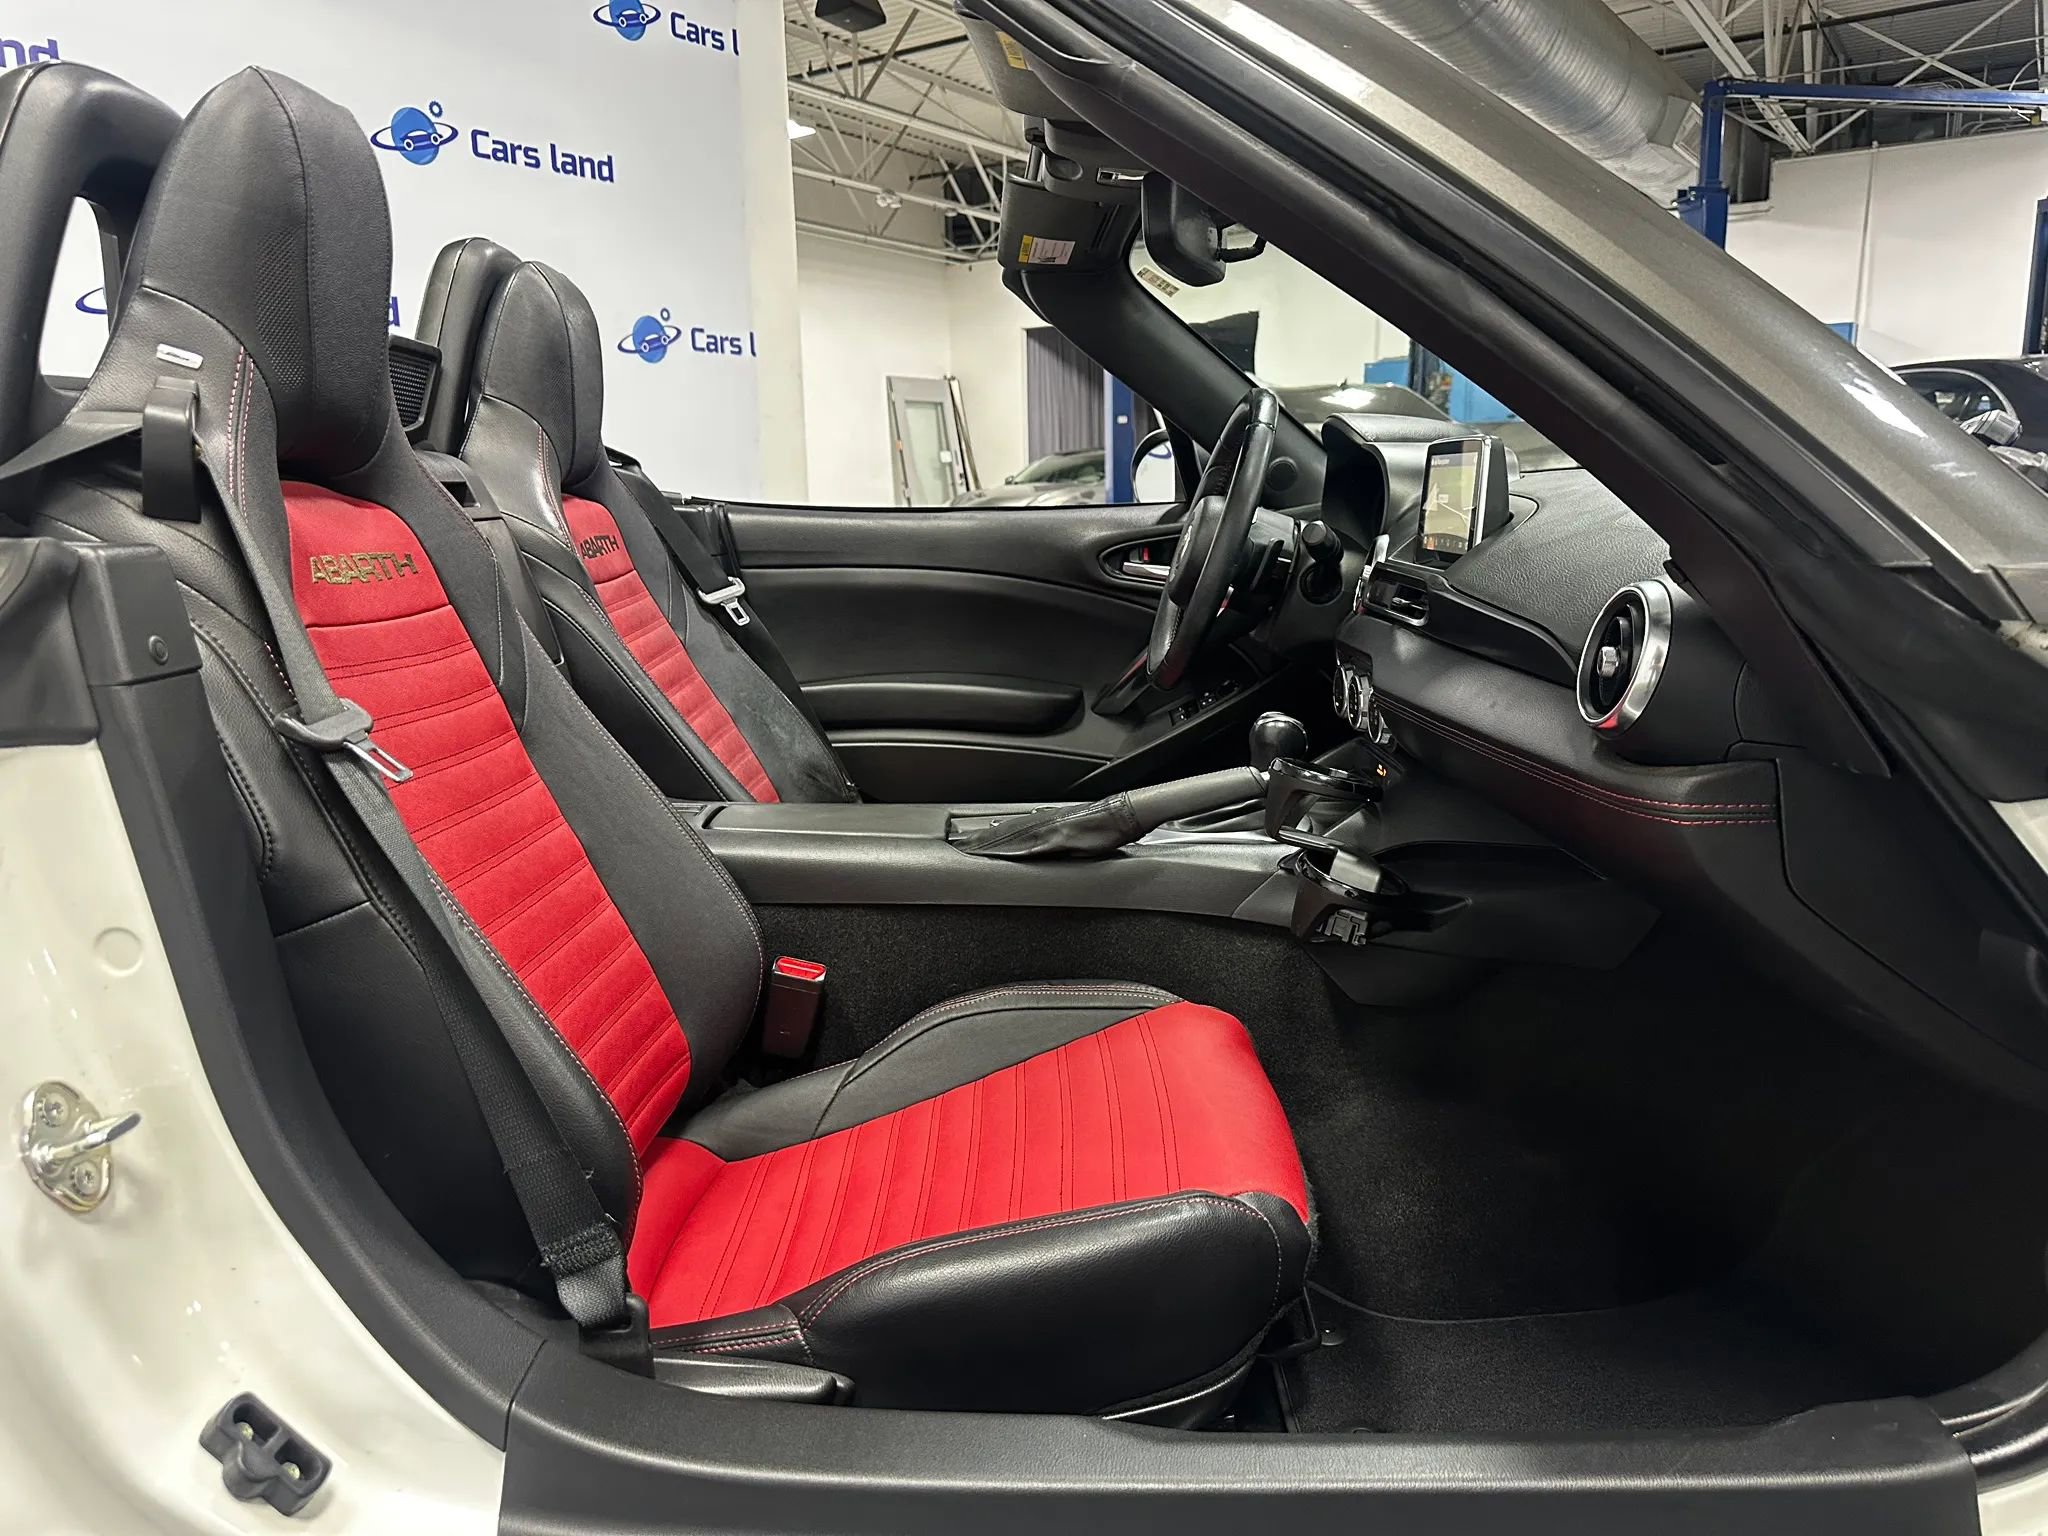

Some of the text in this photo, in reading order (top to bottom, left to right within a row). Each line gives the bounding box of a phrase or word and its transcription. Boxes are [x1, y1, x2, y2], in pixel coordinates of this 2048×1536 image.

[670, 11, 725, 51] Cars
[471, 129, 615, 183] Cars land
[691, 327, 742, 356] Cars
[580, 535, 619, 559] ABARTH
[310, 552, 418, 584] ABARTH
